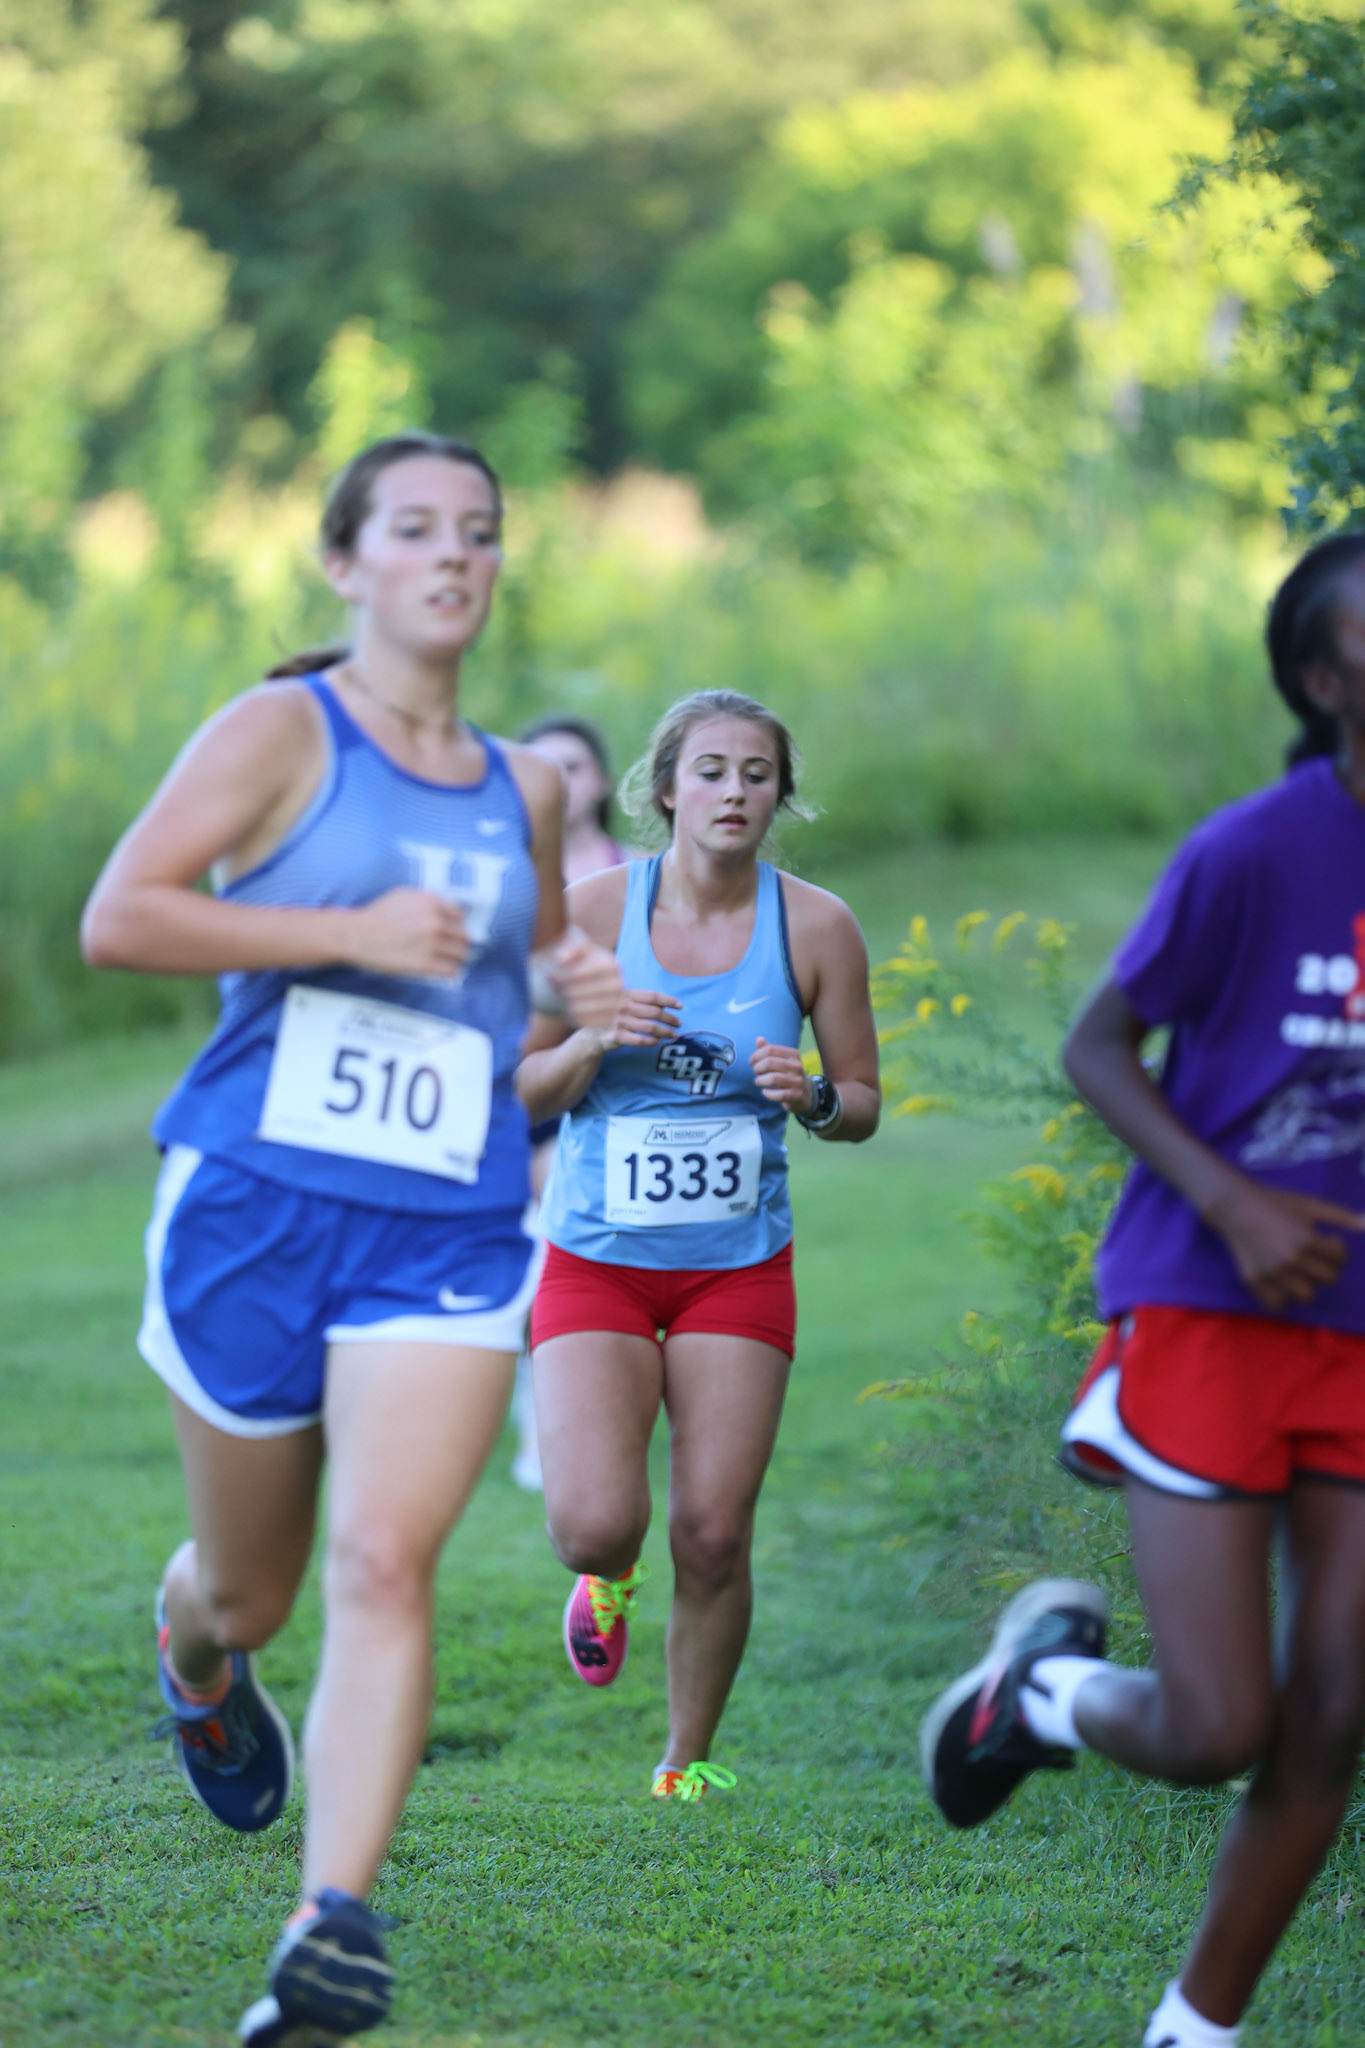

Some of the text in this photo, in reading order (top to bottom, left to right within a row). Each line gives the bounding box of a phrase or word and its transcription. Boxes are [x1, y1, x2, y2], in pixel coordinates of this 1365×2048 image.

[324, 1047, 443, 1131] 510
[657, 1044, 720, 1095] SBA
[624, 1152, 741, 1202] 1333
